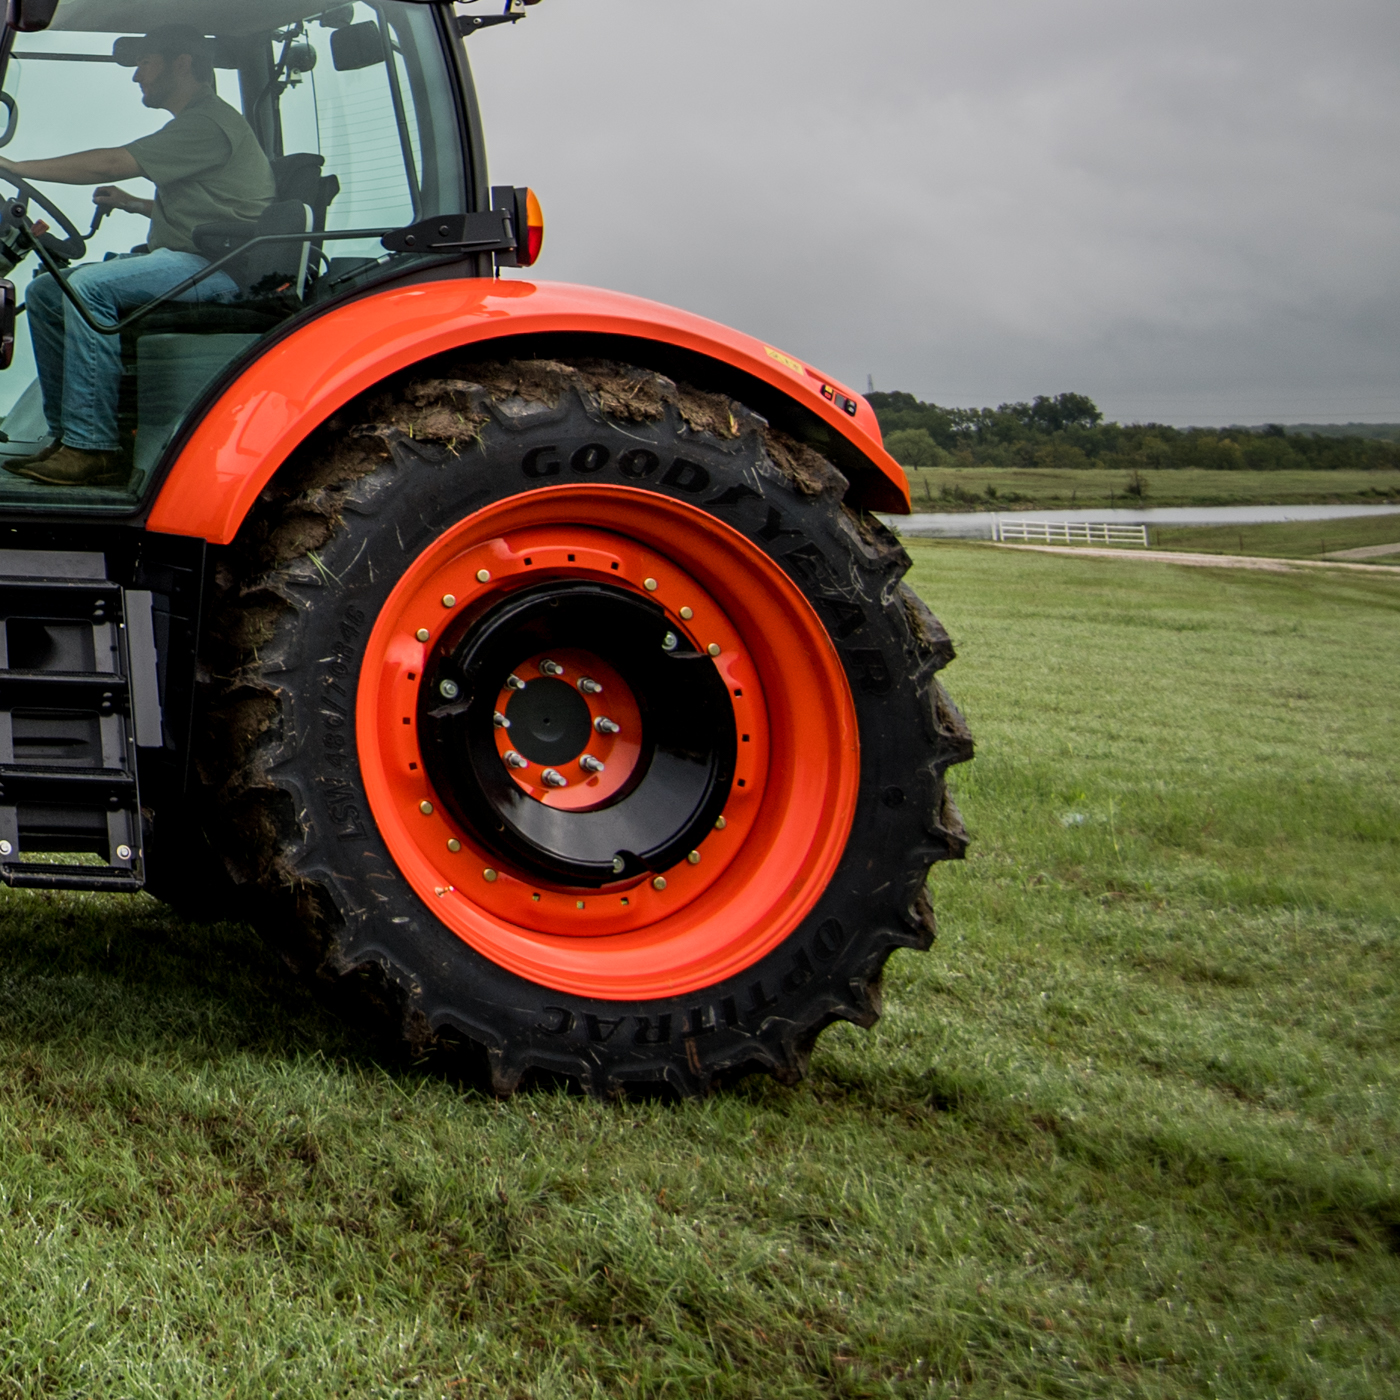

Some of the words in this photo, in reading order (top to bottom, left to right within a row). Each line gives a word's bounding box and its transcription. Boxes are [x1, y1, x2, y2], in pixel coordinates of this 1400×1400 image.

[521, 442, 892, 695] GOODYEAR
[323, 778, 368, 843] LSW
[535, 917, 844, 1047] OPTITRAC
